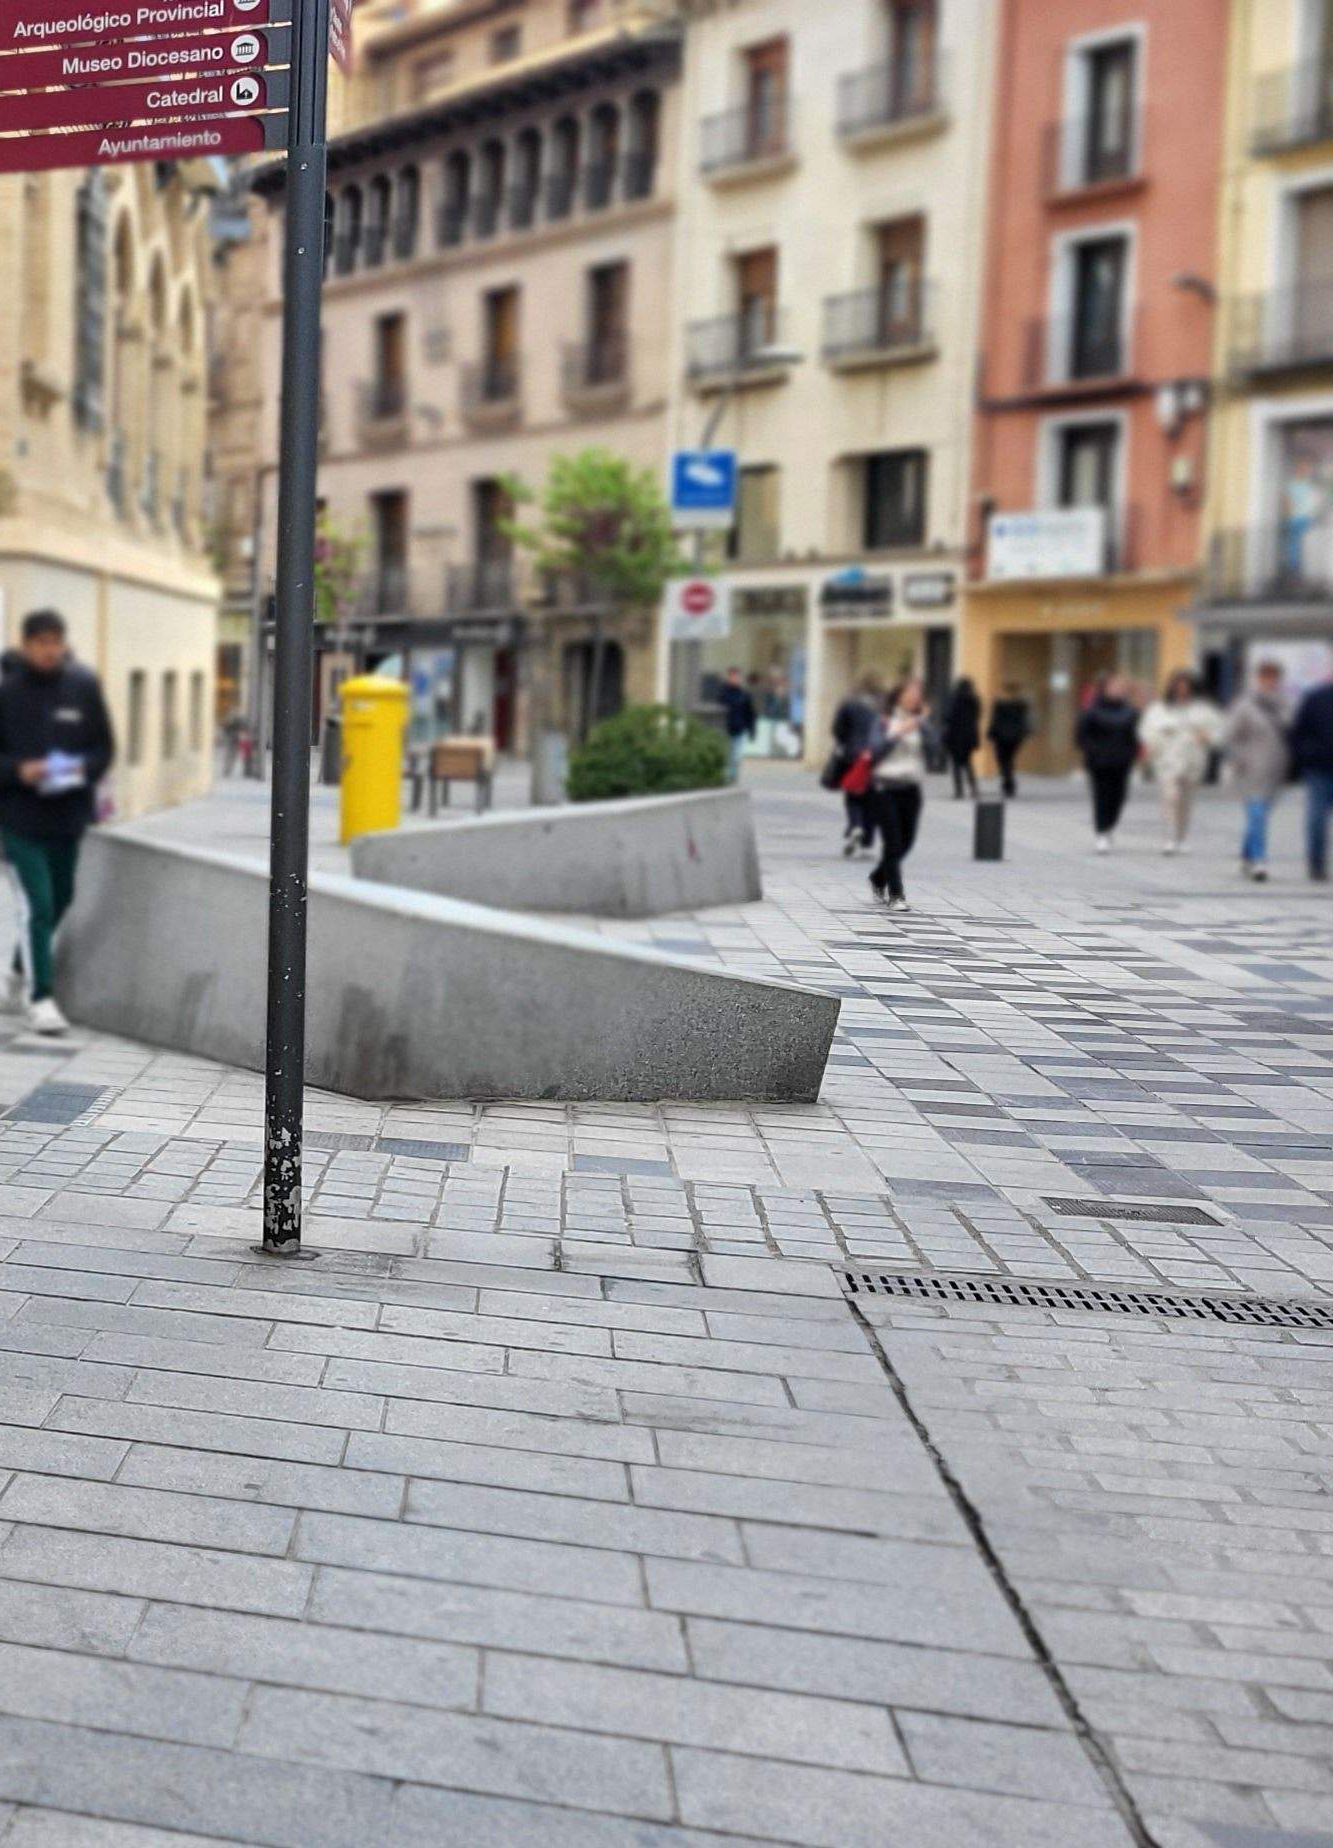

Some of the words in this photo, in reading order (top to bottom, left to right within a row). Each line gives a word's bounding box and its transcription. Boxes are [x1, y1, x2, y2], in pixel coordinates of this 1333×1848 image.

[13, 12, 131, 38] Arqueológico
[137, 0, 224, 24] Provincial
[62, 54, 122, 75] Museo
[128, 46, 224, 68] Diocesano
[146, 85, 224, 108] Catedral
[97, 130, 222, 157] Ayuntamiento
